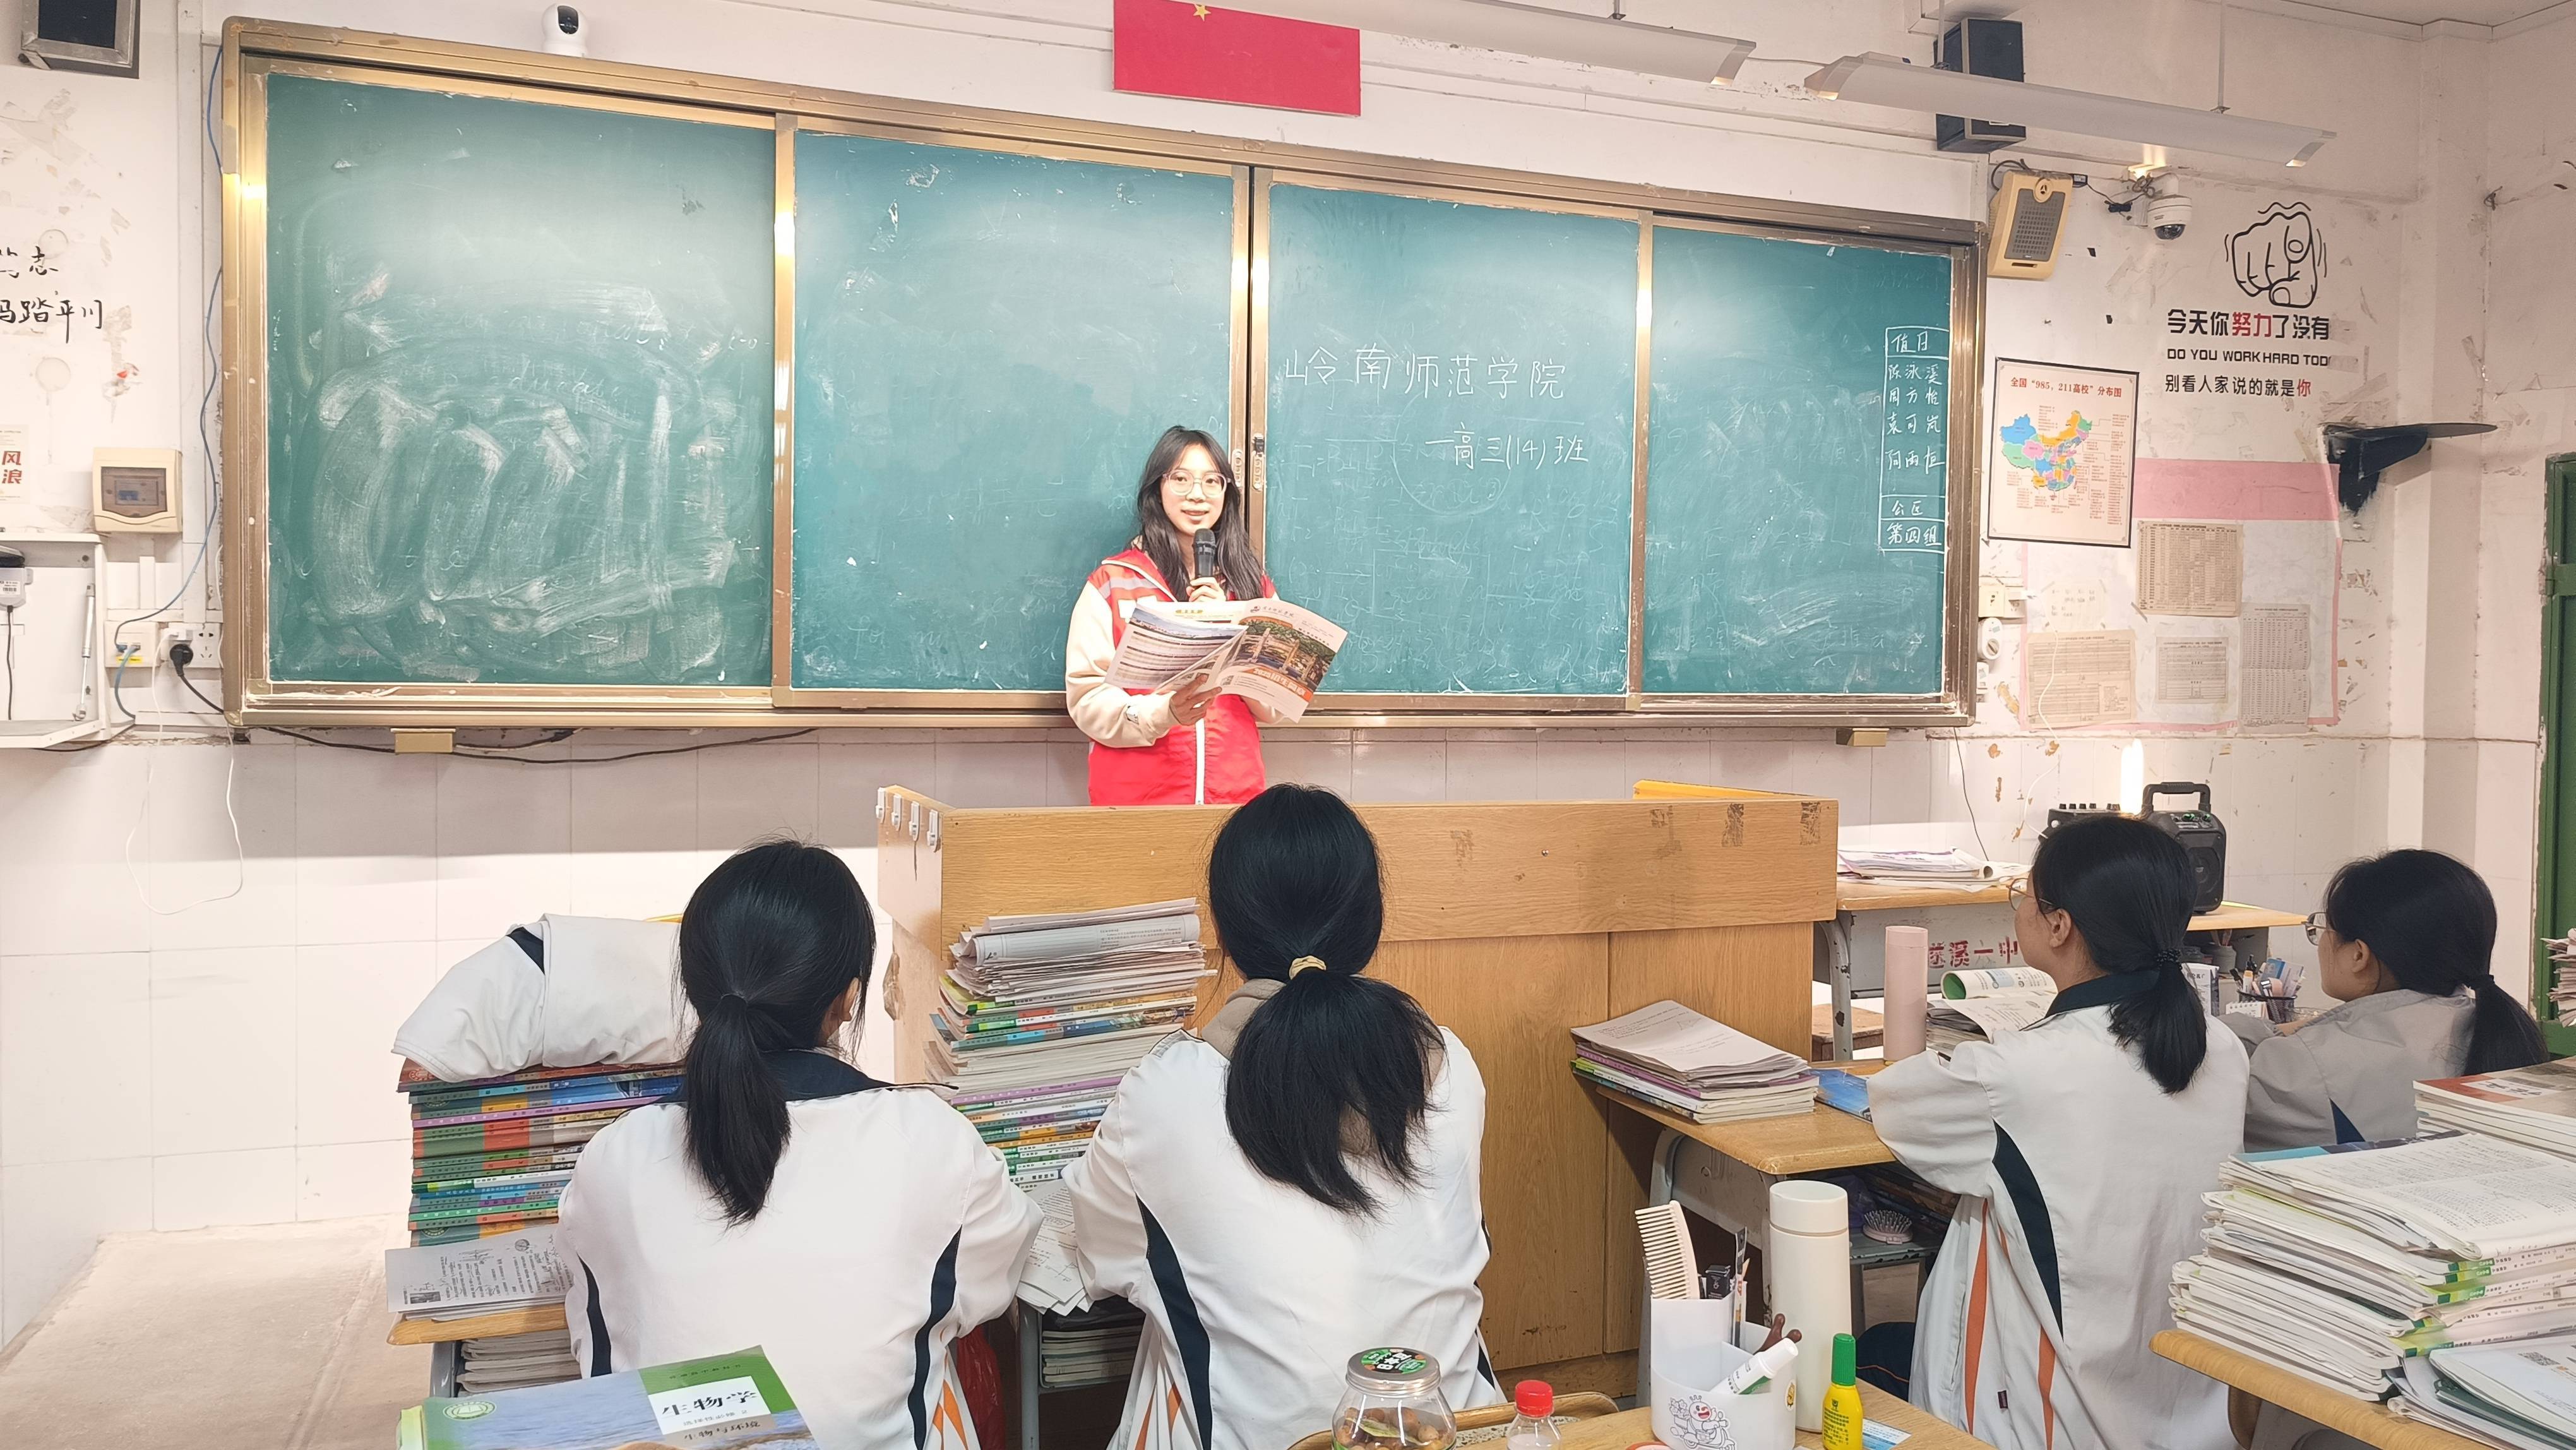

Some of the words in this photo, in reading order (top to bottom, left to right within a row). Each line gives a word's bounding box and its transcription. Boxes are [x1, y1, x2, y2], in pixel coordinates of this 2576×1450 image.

[2167, 308, 2330, 340] 今天你努力了没有
[1285, 342, 1566, 399] 岭南师范学院
[2167, 349, 2186, 359] DO
[2190, 349, 2218, 361] YOU
[2222, 351, 2261, 363] WORK
[2262, 352, 2299, 365] HARD
[2164, 374, 2311, 397] 别看人家说的就是你
[661, 1390, 758, 1418] 生物学
